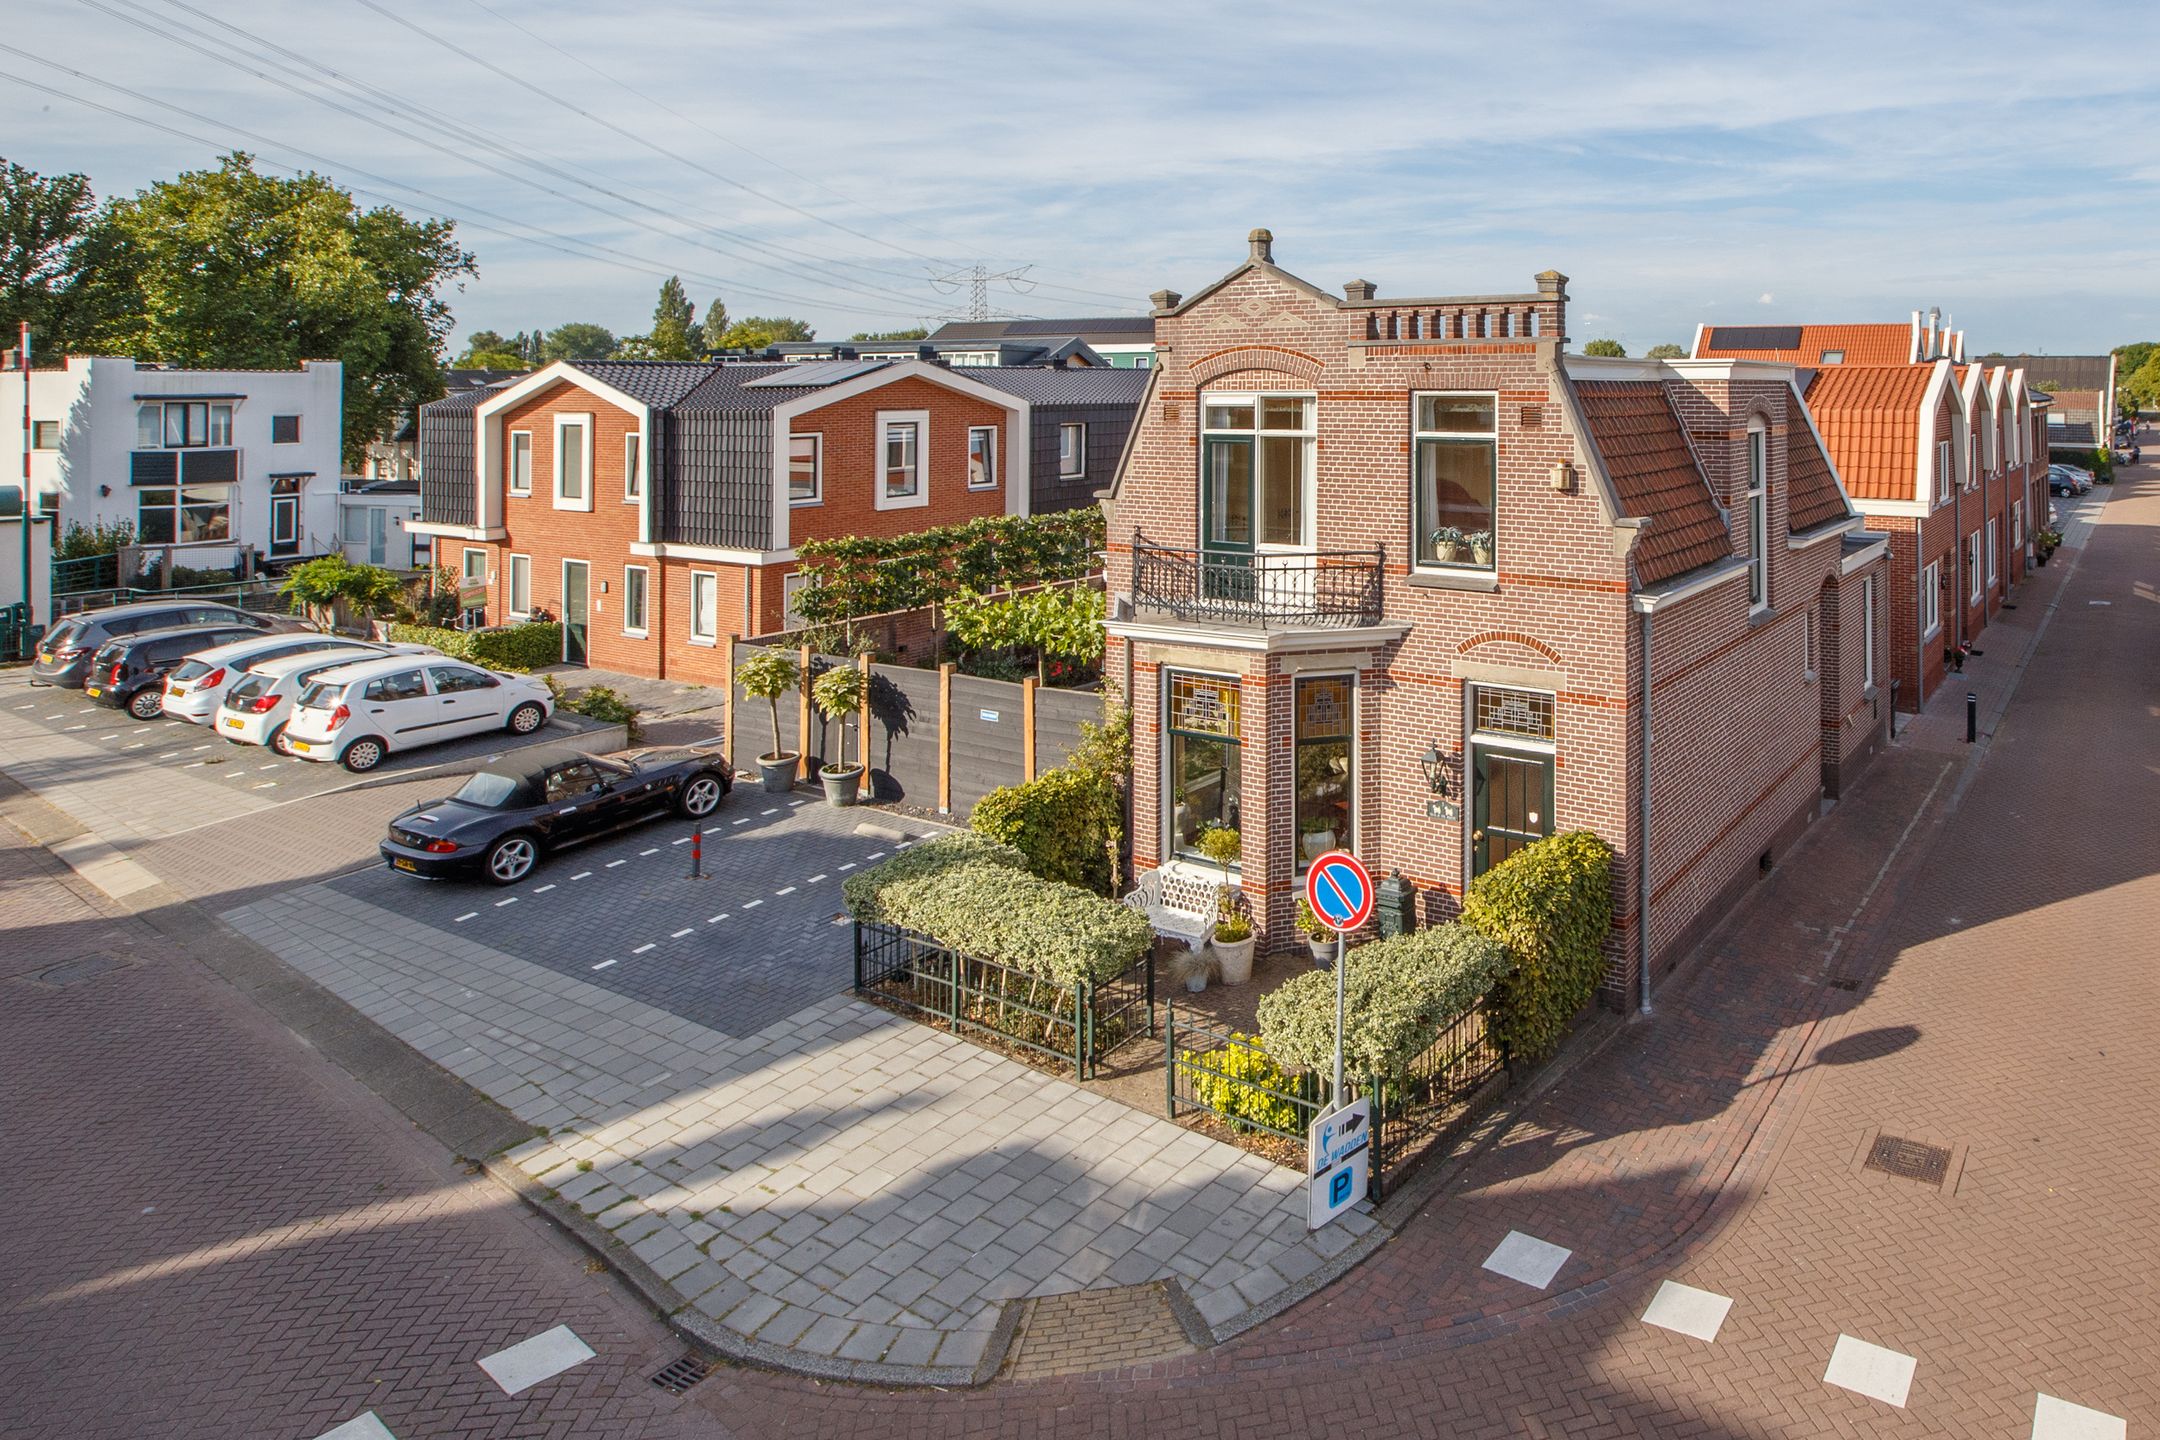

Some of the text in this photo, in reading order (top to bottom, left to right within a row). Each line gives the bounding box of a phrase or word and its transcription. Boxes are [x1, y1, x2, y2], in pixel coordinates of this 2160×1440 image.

[1317, 1130, 1367, 1170] DE WADDEN
[1334, 1172, 1349, 1203] P
